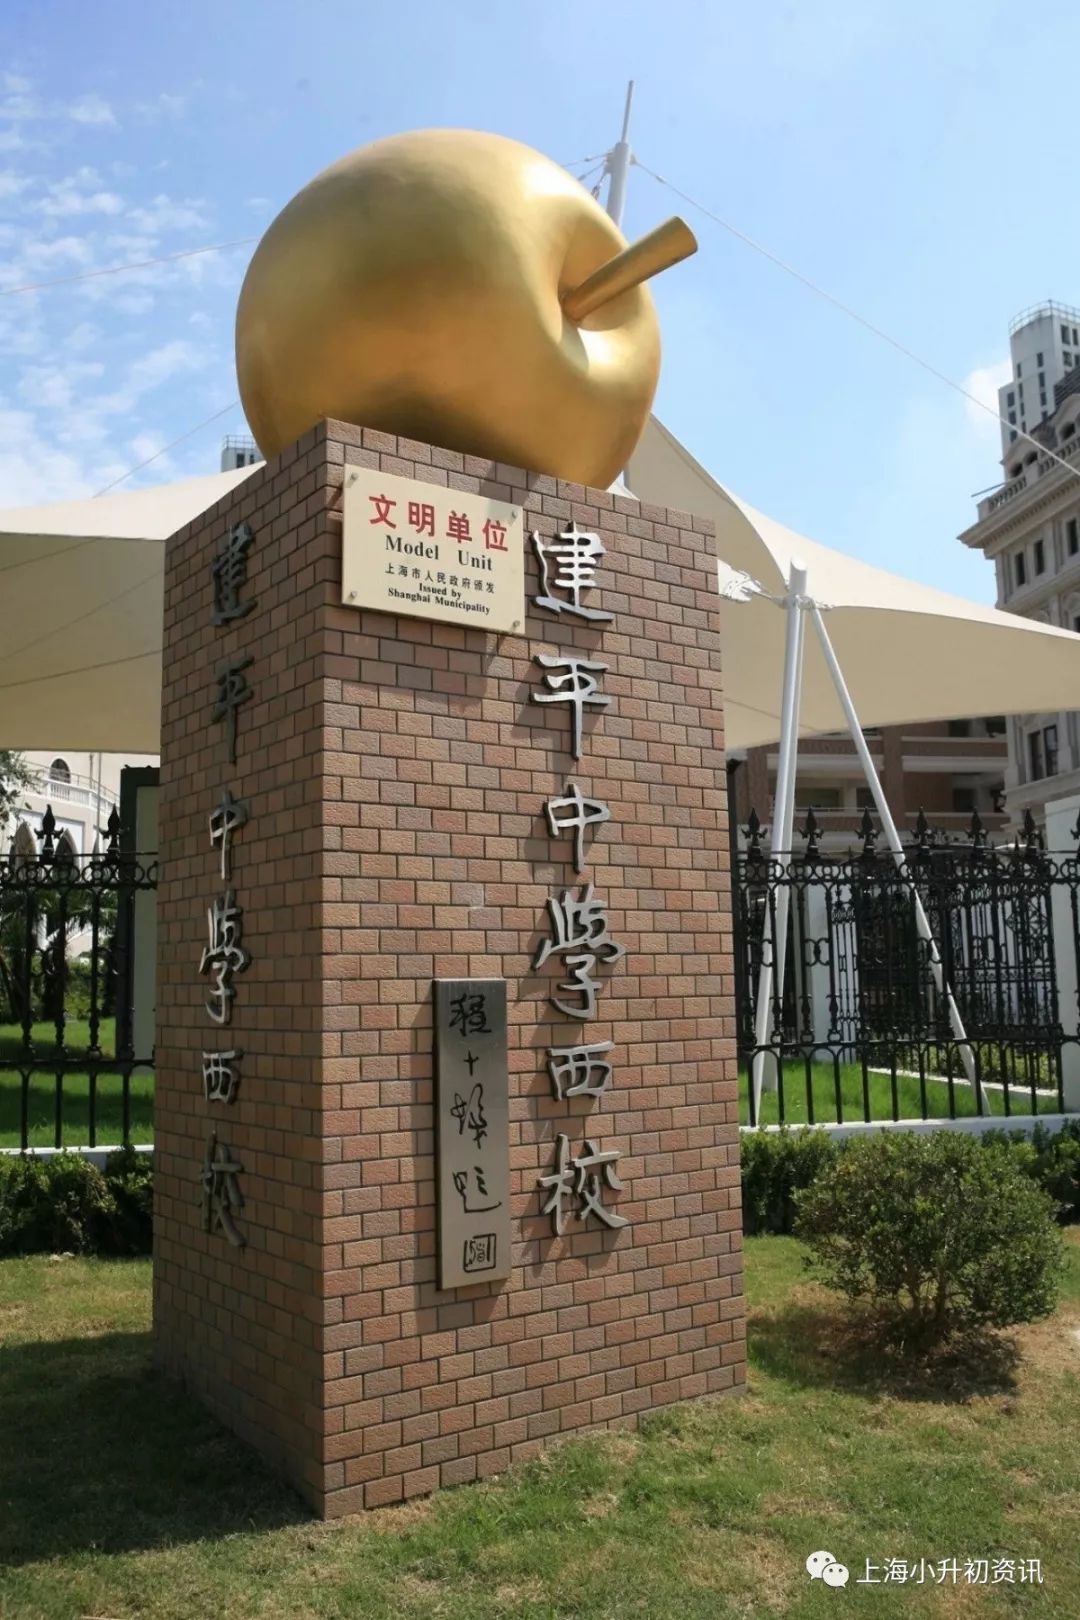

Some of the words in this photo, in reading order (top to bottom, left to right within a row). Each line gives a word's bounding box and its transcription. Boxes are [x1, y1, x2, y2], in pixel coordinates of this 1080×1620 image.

[368, 493, 509, 552] 文明单位
[385, 534, 440, 561] Model
[457, 549, 493, 571] Unit
[384, 562, 495, 594] 上海市人民政府颁发
[418, 582, 448, 596] Issued
[451, 587, 462, 600] by
[387, 587, 431, 603] Shanghai
[434, 595, 491, 616] Municipality
